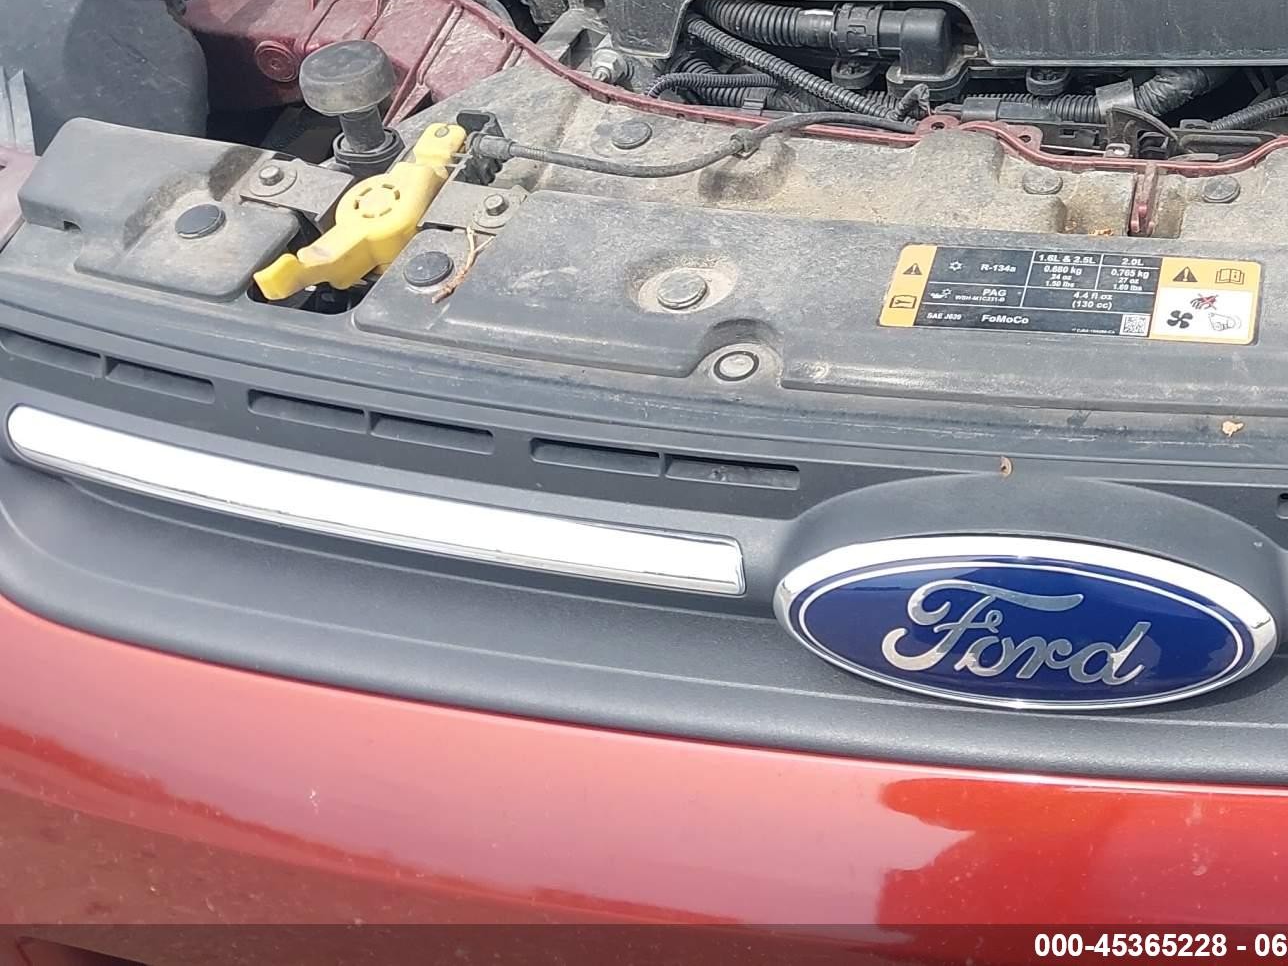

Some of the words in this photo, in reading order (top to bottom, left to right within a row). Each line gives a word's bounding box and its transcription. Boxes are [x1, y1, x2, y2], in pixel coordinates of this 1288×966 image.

[1039, 254, 1060, 262] 1.6L
[1062, 255, 1071, 263] &
[1073, 256, 1096, 264] 2.5L
[1121, 257, 1144, 266] 2.0L
[980, 263, 1017, 273] R-134a
[1070, 265, 1083, 276] kg
[1110, 268, 1136, 277] 0.765
[1137, 270, 1150, 279] kg
[982, 288, 1007, 297] PAG
[1071, 300, 1094, 309] (130
[1096, 301, 1113, 311] cc)
[926, 312, 943, 320] SAE
[981, 314, 1030, 324] FoMoCo
[881, 578, 1152, 686] Ford
